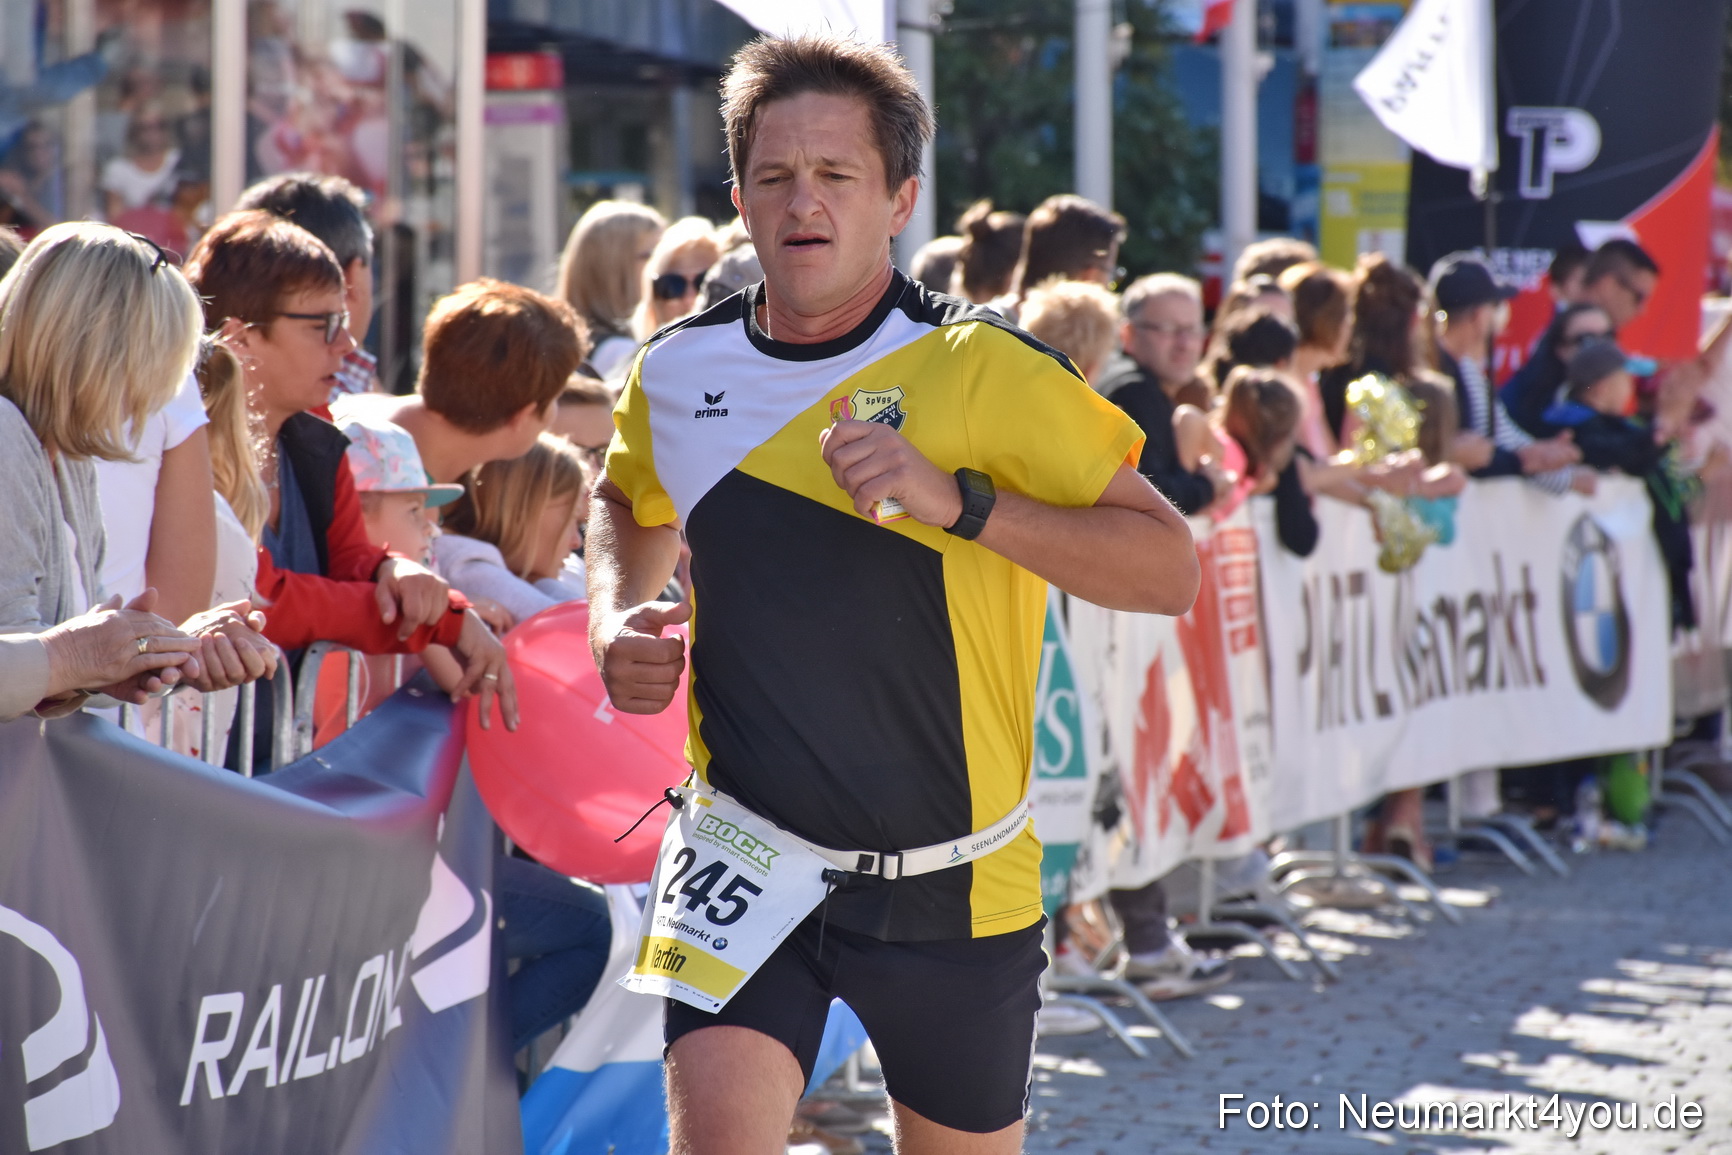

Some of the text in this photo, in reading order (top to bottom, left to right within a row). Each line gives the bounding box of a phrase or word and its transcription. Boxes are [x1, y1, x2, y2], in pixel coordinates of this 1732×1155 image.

[694, 406, 729, 419] erima
[866, 396, 892, 406] SpVgg
[692, 831, 769, 877] inspired by smart concepts
[696, 813, 781, 871] BOCK
[661, 846, 764, 927] 245
[667, 917, 711, 943] Neumarkt
